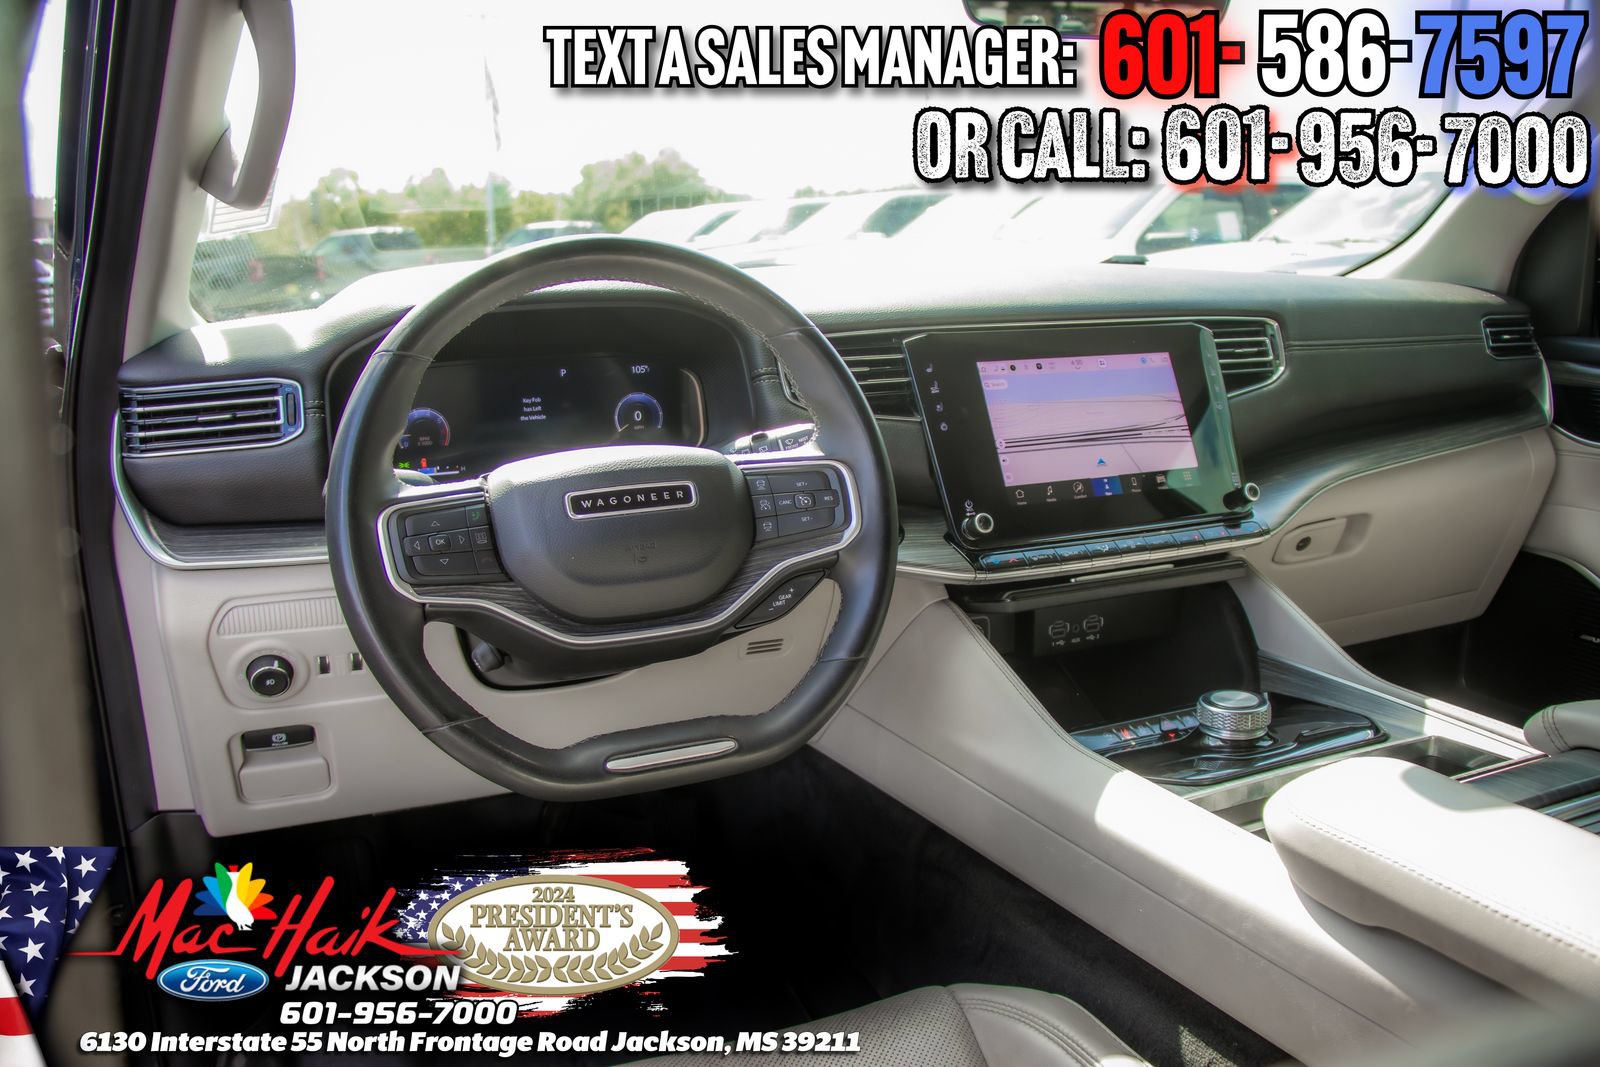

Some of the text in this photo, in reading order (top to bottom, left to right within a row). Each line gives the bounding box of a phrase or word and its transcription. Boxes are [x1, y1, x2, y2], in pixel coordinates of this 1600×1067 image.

[560, 368, 567, 377] P
[634, 410, 642, 421] 0
[580, 490, 684, 509] WAGONEER
[435, 538, 446, 546] OK
[778, 593, 792, 601] GEAR
